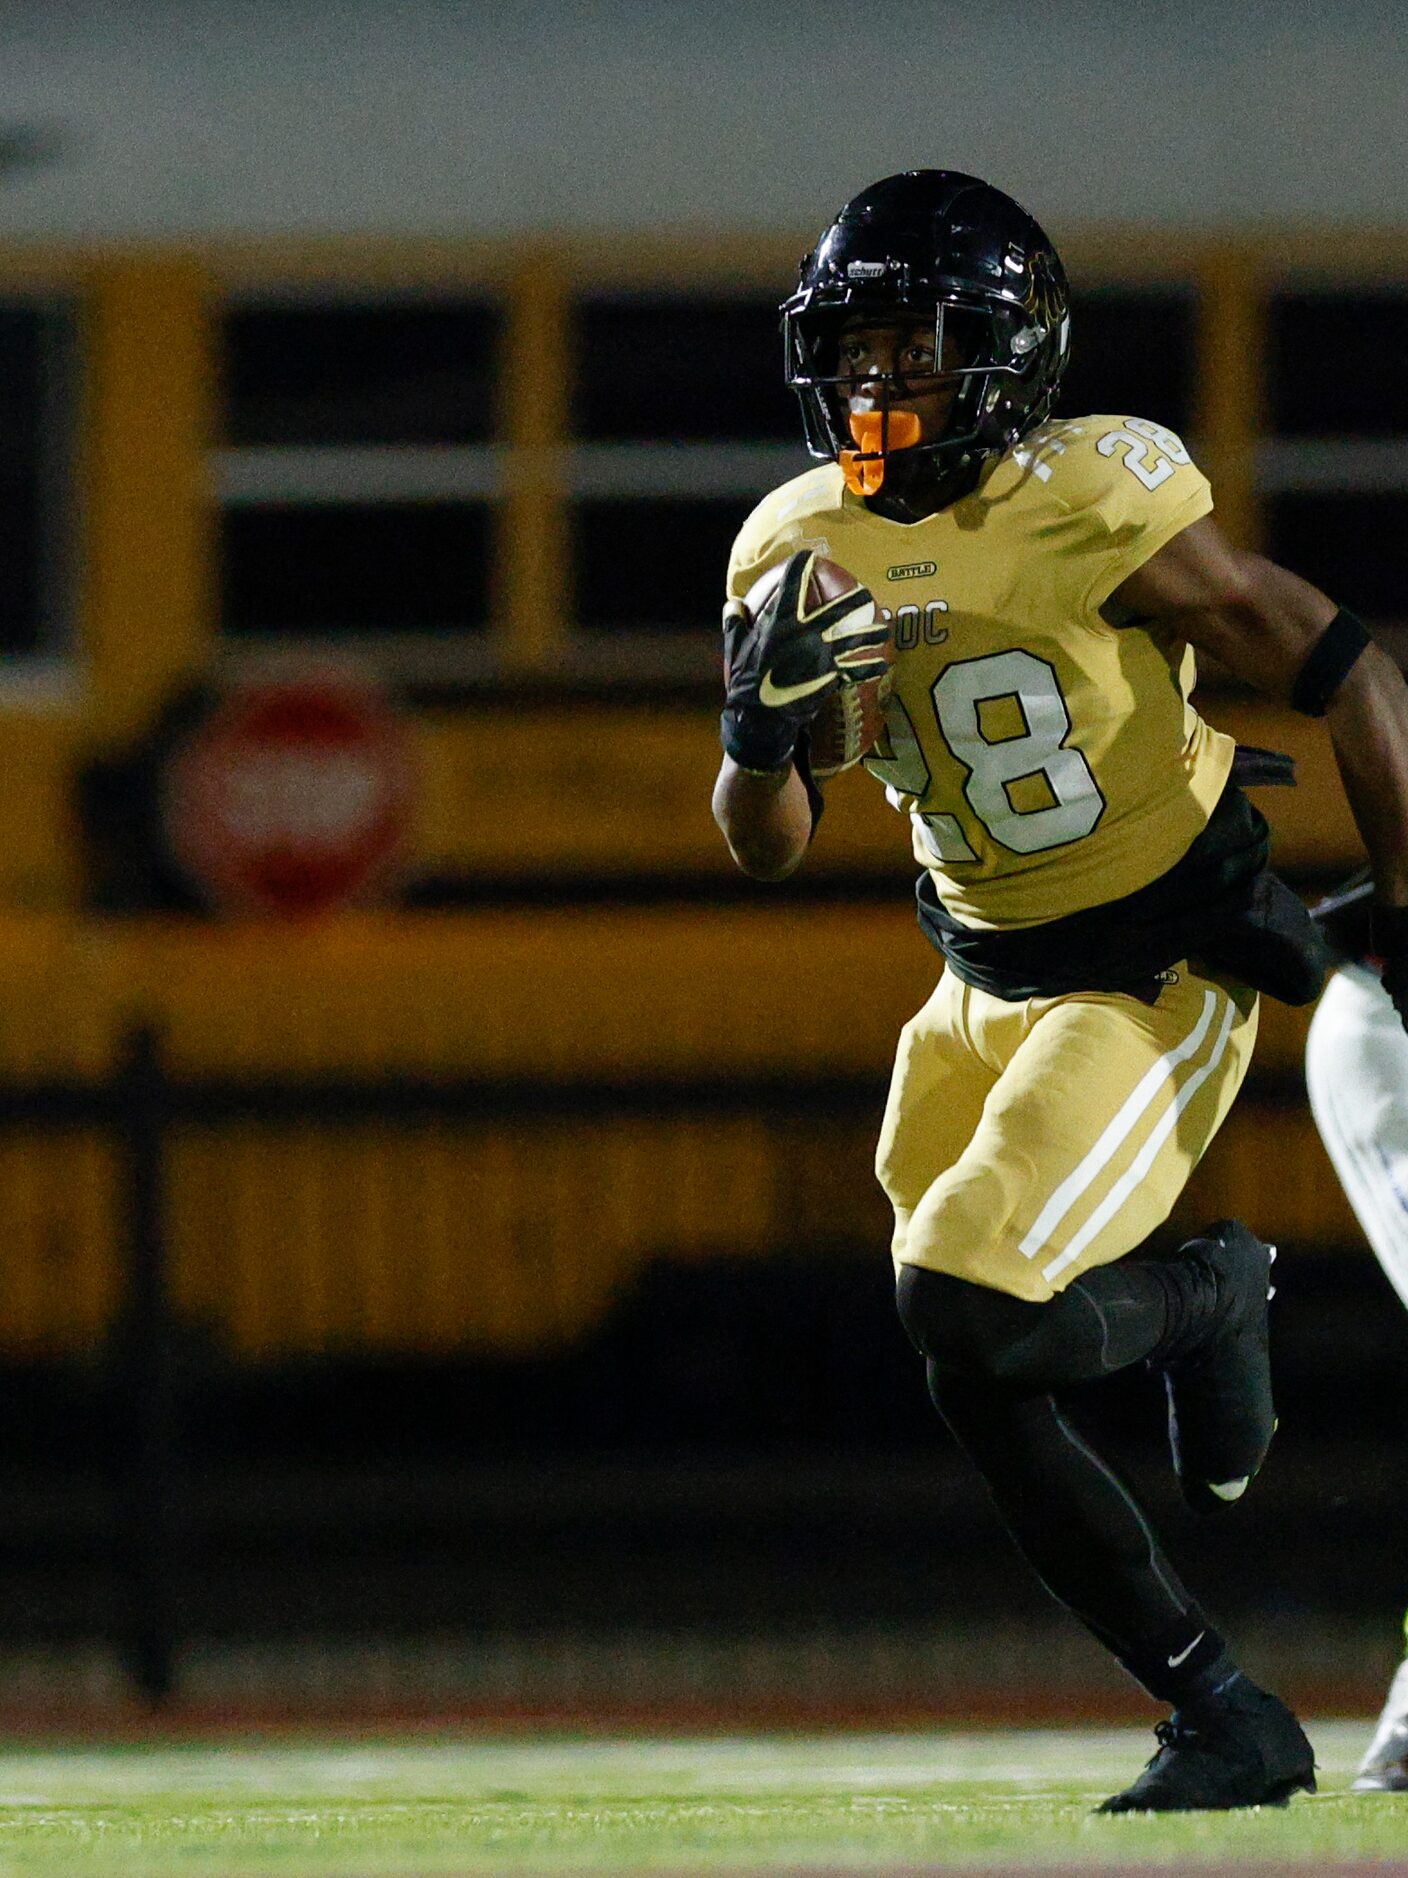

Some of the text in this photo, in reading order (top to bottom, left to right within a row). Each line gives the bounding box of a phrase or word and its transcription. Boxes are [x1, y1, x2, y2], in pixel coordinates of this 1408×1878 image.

[1096, 418, 1192, 493] 28
[890, 564, 932, 578] BATTLE
[881, 599, 949, 650] OC
